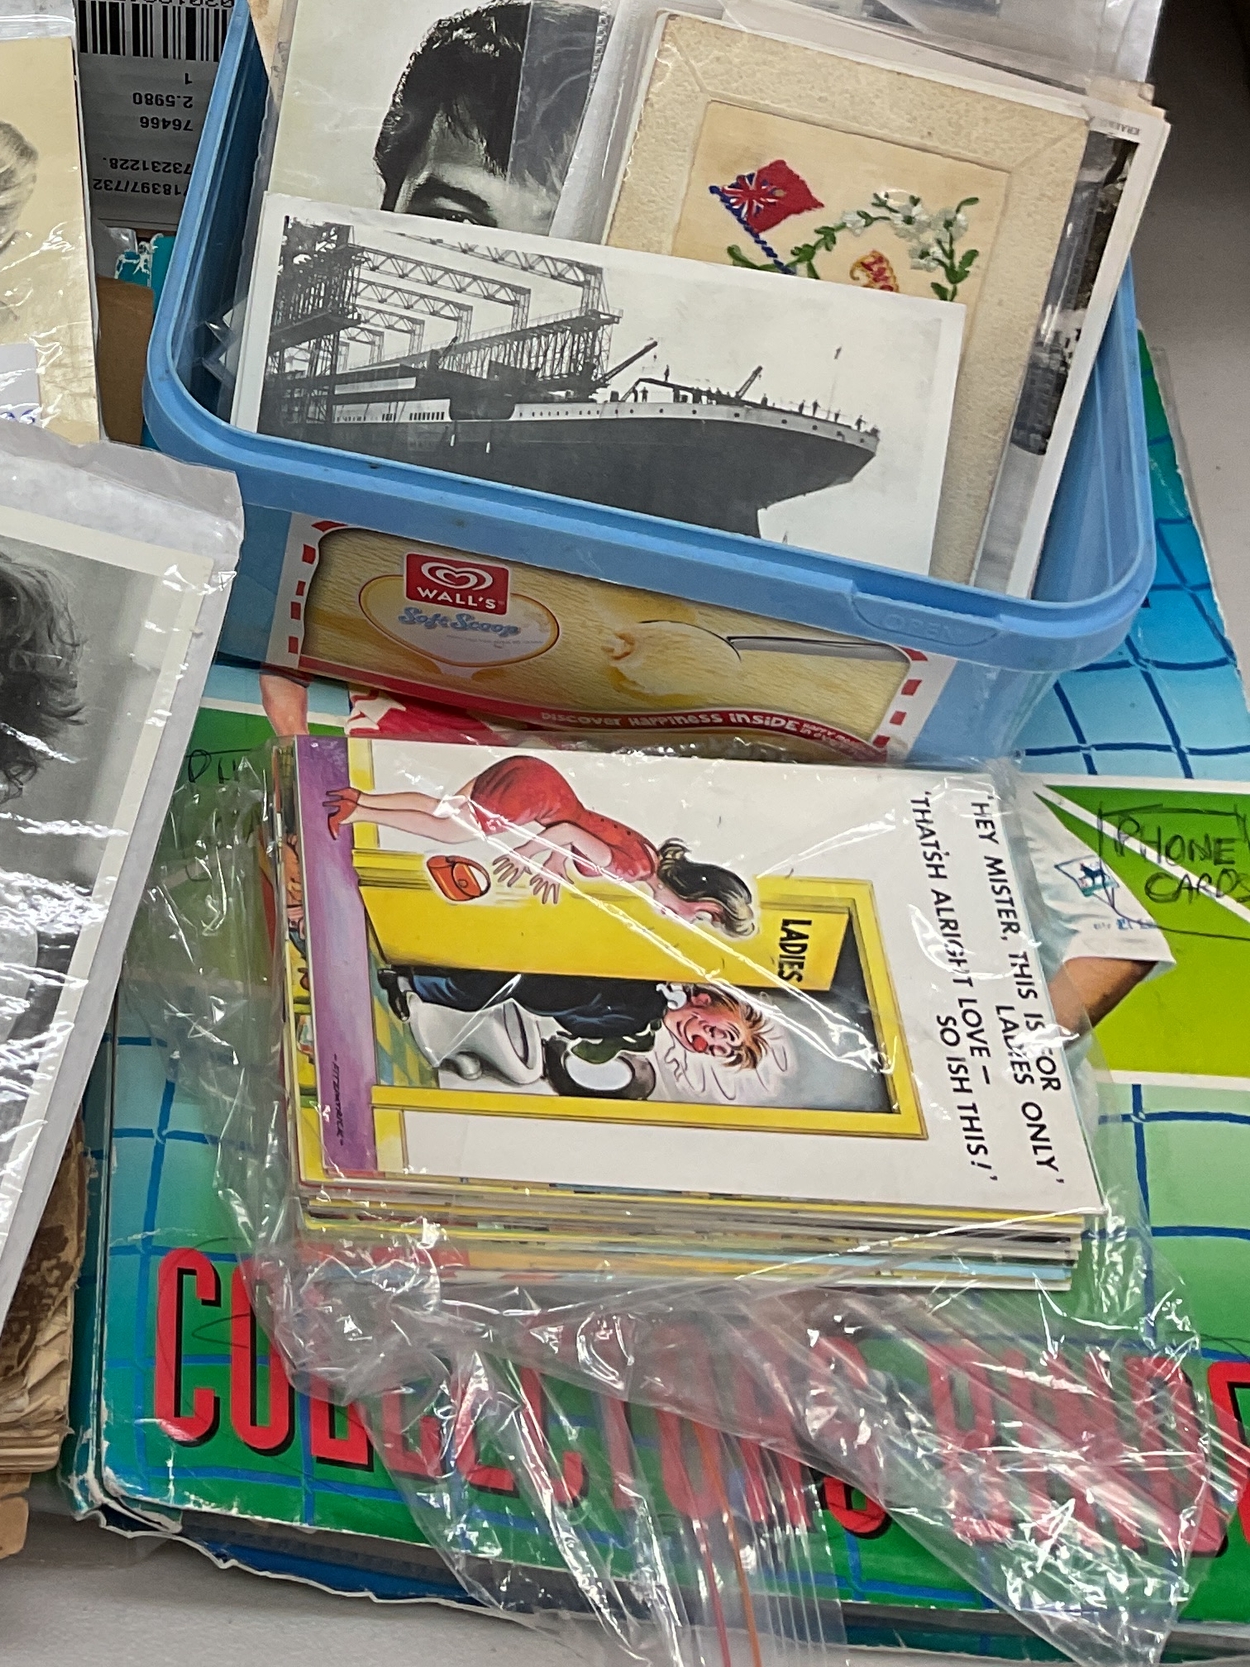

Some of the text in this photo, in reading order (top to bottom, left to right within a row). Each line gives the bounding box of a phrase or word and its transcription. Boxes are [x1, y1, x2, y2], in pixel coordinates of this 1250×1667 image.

[183, 72, 193, 85] 1
[132, 92, 194, 109] 2.5980
[139, 116, 194, 131] 76466
[416, 586, 498, 611] WALL'S
[397, 606, 522, 638] Soft Scoop
[1113, 811, 1237, 867] PHONE
[982, 854, 1020, 943] MISTER,
[1007, 950, 1040, 1001] THIS
[776, 916, 813, 985] LADIES
[930, 887, 974, 987] ALRIGHT
[957, 997, 992, 1059] LOVE
[936, 1013, 961, 1048] SO
[944, 1057, 974, 1095] ISH
